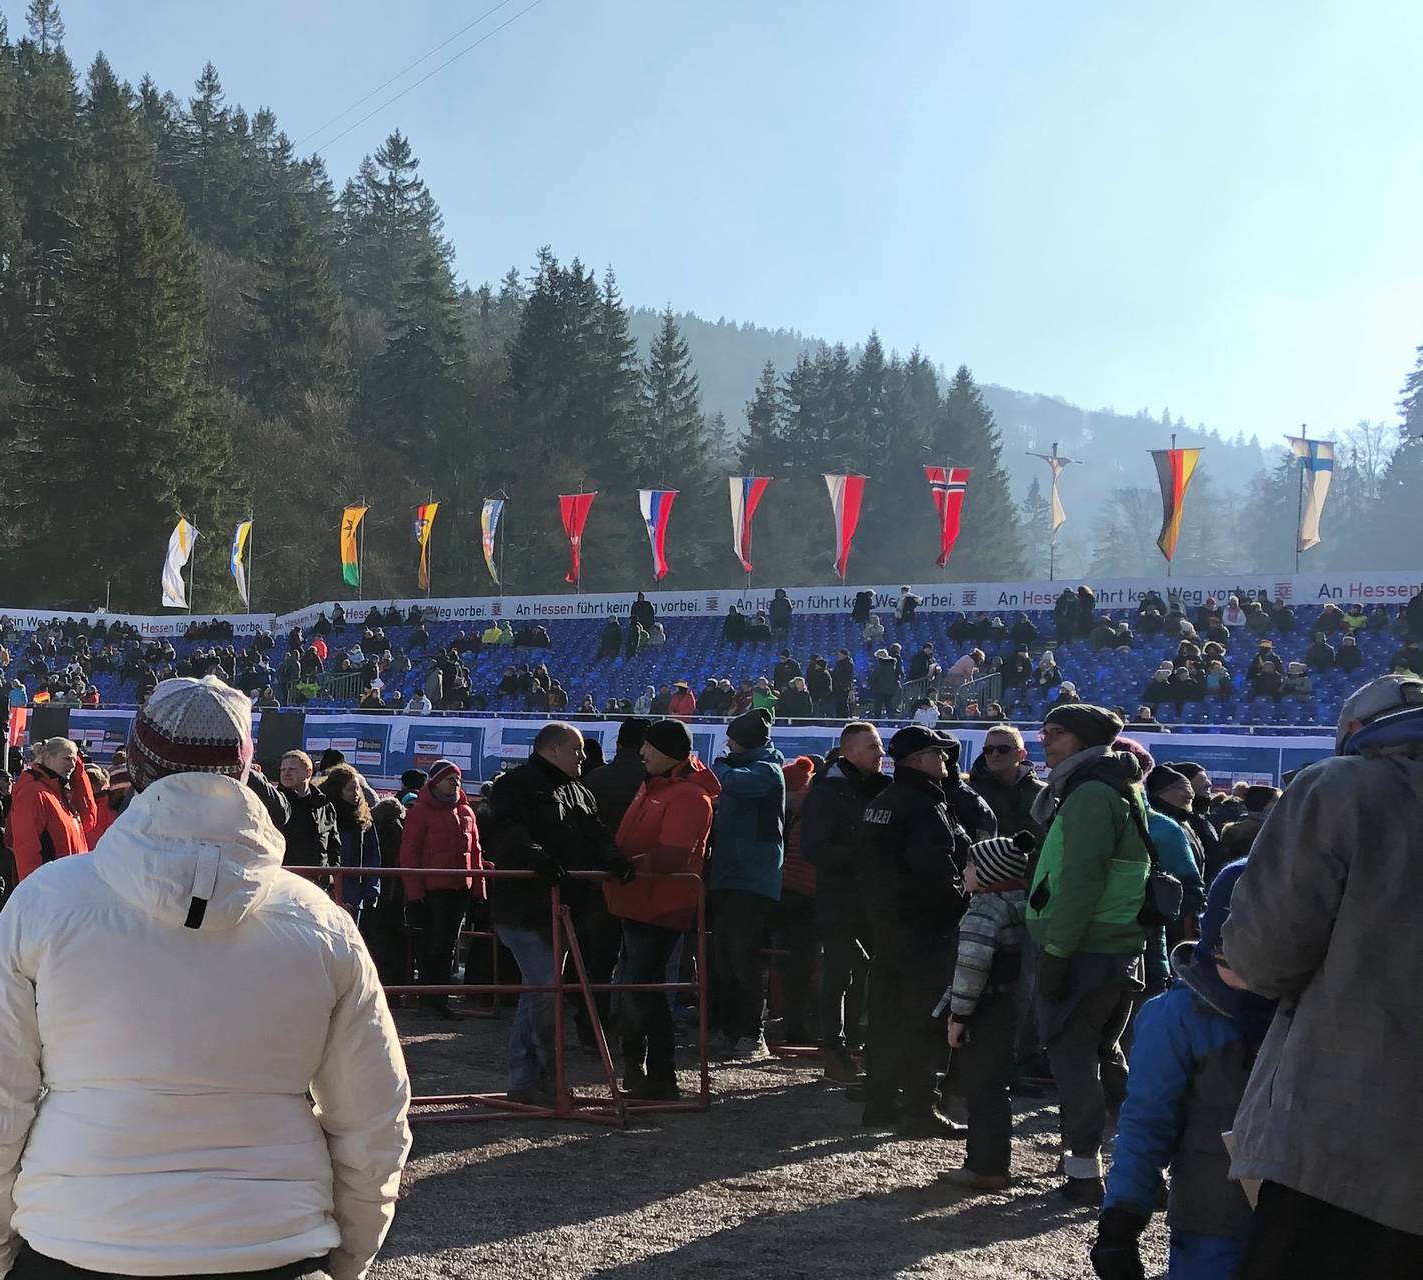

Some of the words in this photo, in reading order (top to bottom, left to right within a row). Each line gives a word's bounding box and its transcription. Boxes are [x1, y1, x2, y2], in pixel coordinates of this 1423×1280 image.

[1318, 583, 1343, 599] An
[1349, 582, 1420, 599] Hessen
[737, 598, 753, 611] An
[756, 597, 804, 610] Heen
[807, 595, 840, 609] führt
[997, 591, 1018, 606] An
[453, 605, 487, 617] vorbei.
[516, 603, 531, 615] An
[534, 603, 574, 615] Hessen
[577, 601, 604, 615] führt
[607, 600, 630, 614] kein
[661, 599, 701, 613] vorbei.
[141, 622, 174, 634] Hessen
